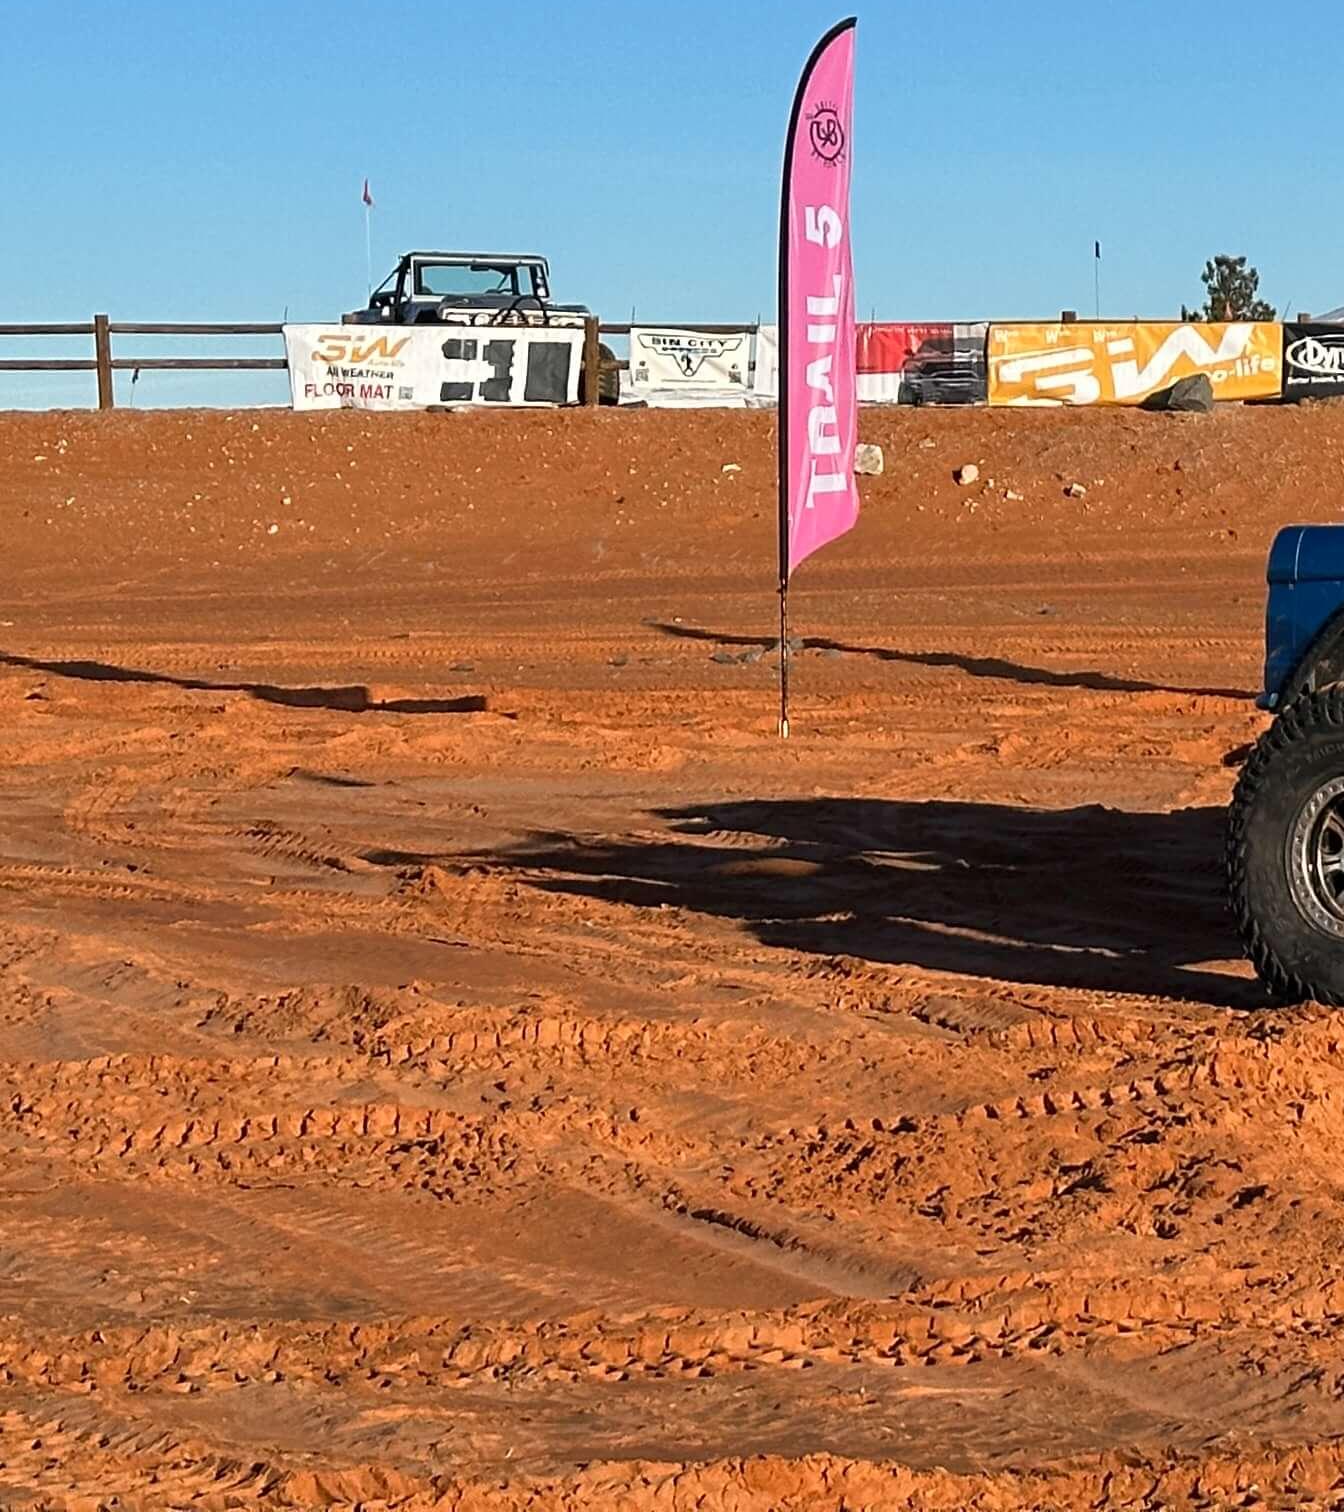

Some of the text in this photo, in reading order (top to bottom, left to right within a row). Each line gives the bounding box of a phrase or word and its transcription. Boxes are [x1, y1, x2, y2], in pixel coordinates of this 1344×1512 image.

[804, 204, 843, 250] 5
[304, 382, 394, 400] FLOOR MAT
[806, 274, 848, 509] TRAIL
